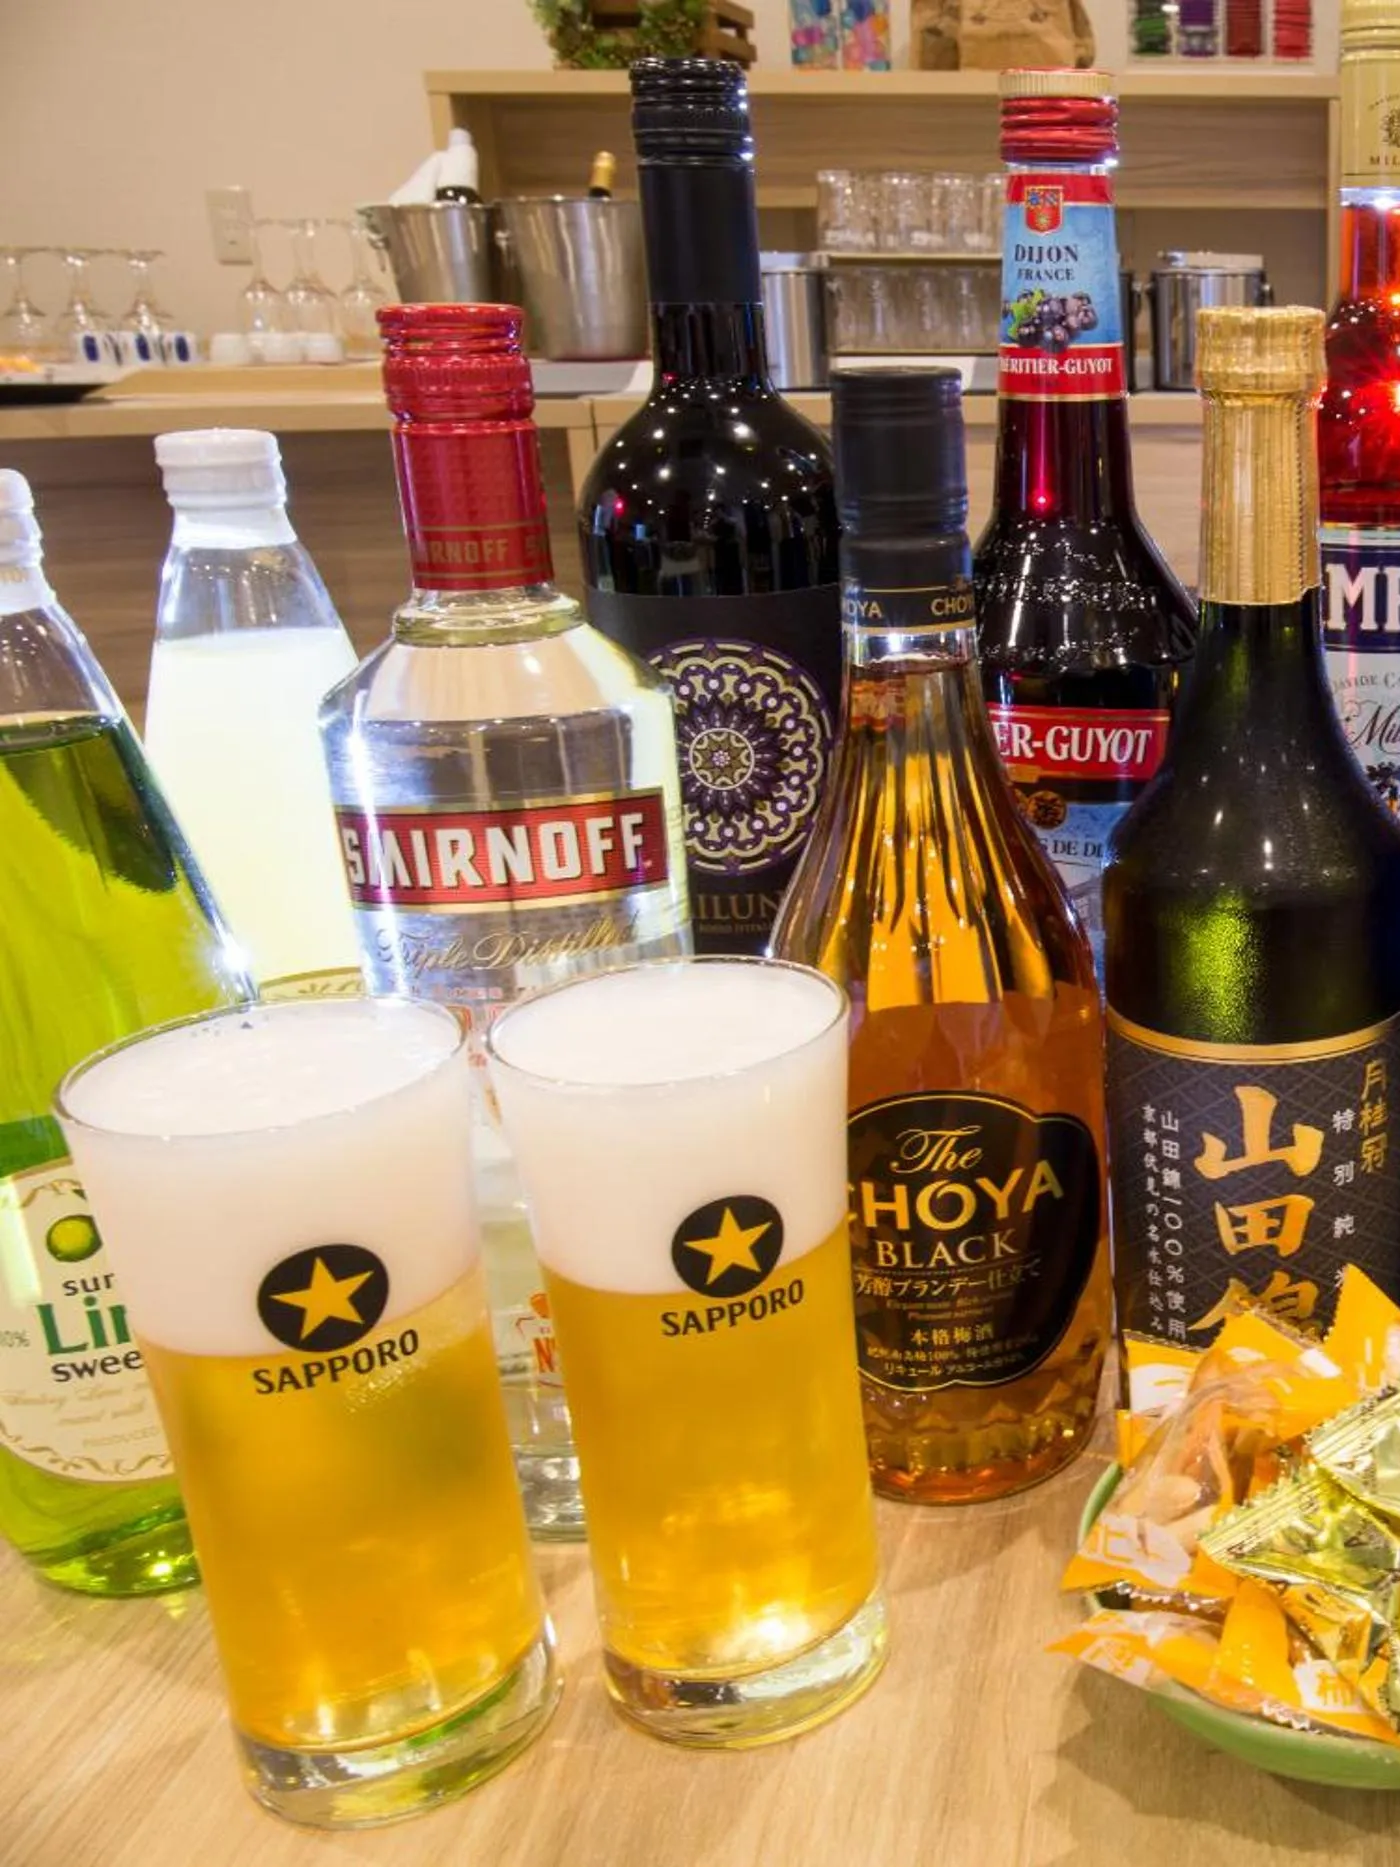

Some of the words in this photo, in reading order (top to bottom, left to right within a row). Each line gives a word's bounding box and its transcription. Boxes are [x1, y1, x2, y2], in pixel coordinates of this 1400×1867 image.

[1013, 243, 1079, 264] DIJON
[1016, 267, 1076, 281] FRANCE
[343, 812, 644, 888] SMIRNOFF
[1051, 839, 1078, 855] DE
[374, 927, 473, 978] Triple
[1360, 1058, 1389, 1174] 月桂冠
[889, 1125, 983, 1174] The
[875, 1228, 1019, 1269] BLACK
[660, 1278, 805, 1337] SAPPORO
[253, 1329, 420, 1395] SAPPORO
